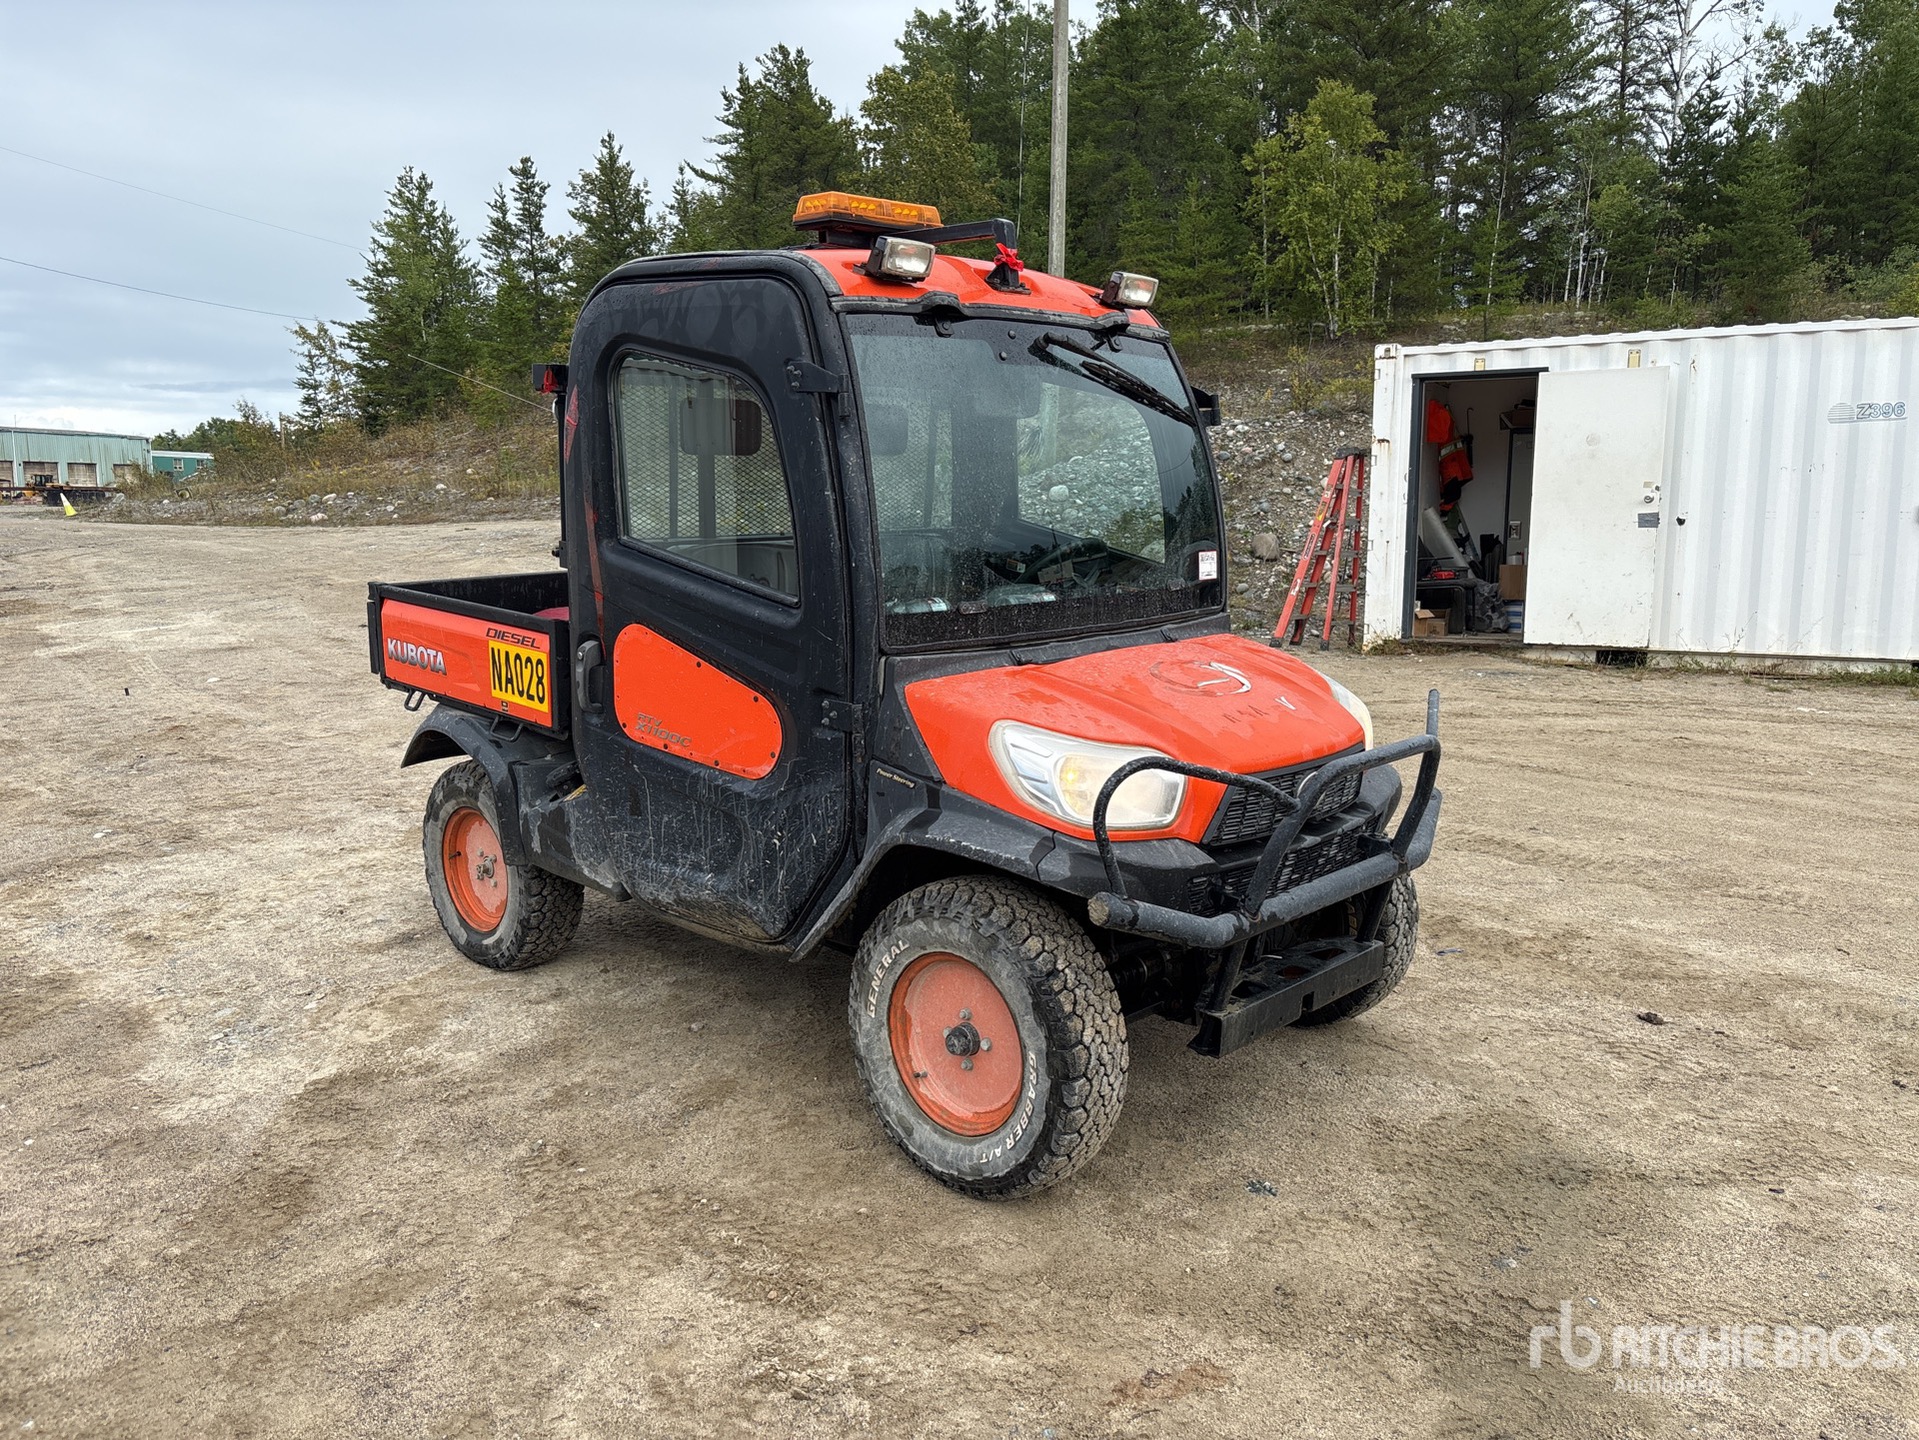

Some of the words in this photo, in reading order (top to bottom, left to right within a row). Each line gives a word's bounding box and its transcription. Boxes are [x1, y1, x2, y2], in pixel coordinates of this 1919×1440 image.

[1856, 401, 1906, 420] Z396
[486, 627, 541, 650] DIESEL
[387, 637, 448, 676] KUBOTA
[490, 646, 546, 705] NA028
[636, 712, 663, 726] RTV
[876, 767, 893, 779] Power
[892, 774, 916, 789] Steering
[866, 938, 911, 1019] GENERAL
[1005, 1050, 1039, 1151] GRABBER
[979, 1147, 1003, 1164] A/T
